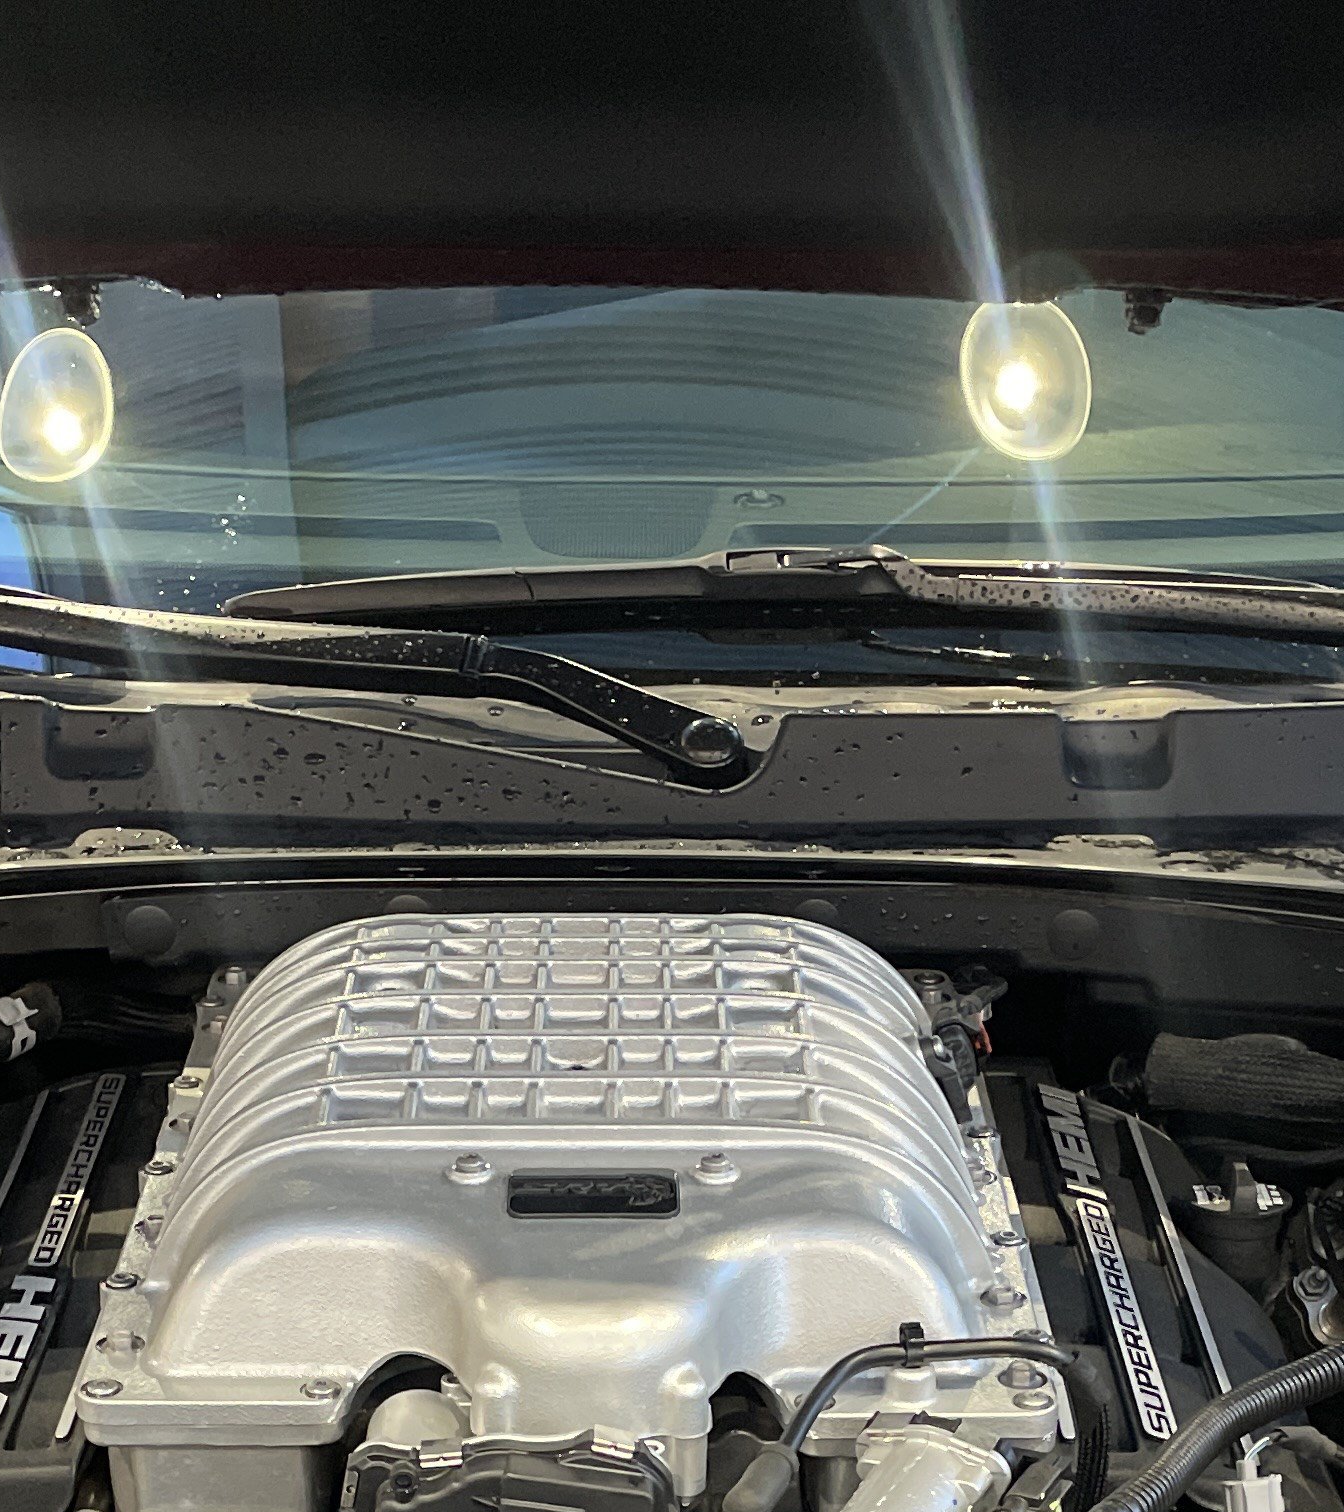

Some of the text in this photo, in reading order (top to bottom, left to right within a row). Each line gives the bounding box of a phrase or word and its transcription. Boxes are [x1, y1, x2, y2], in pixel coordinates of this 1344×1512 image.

[33, 1075, 123, 1265] SUPERCHARGED
[1038, 1083, 1108, 1200] HEMI
[1082, 1200, 1173, 1439] SUPERCHARGED
